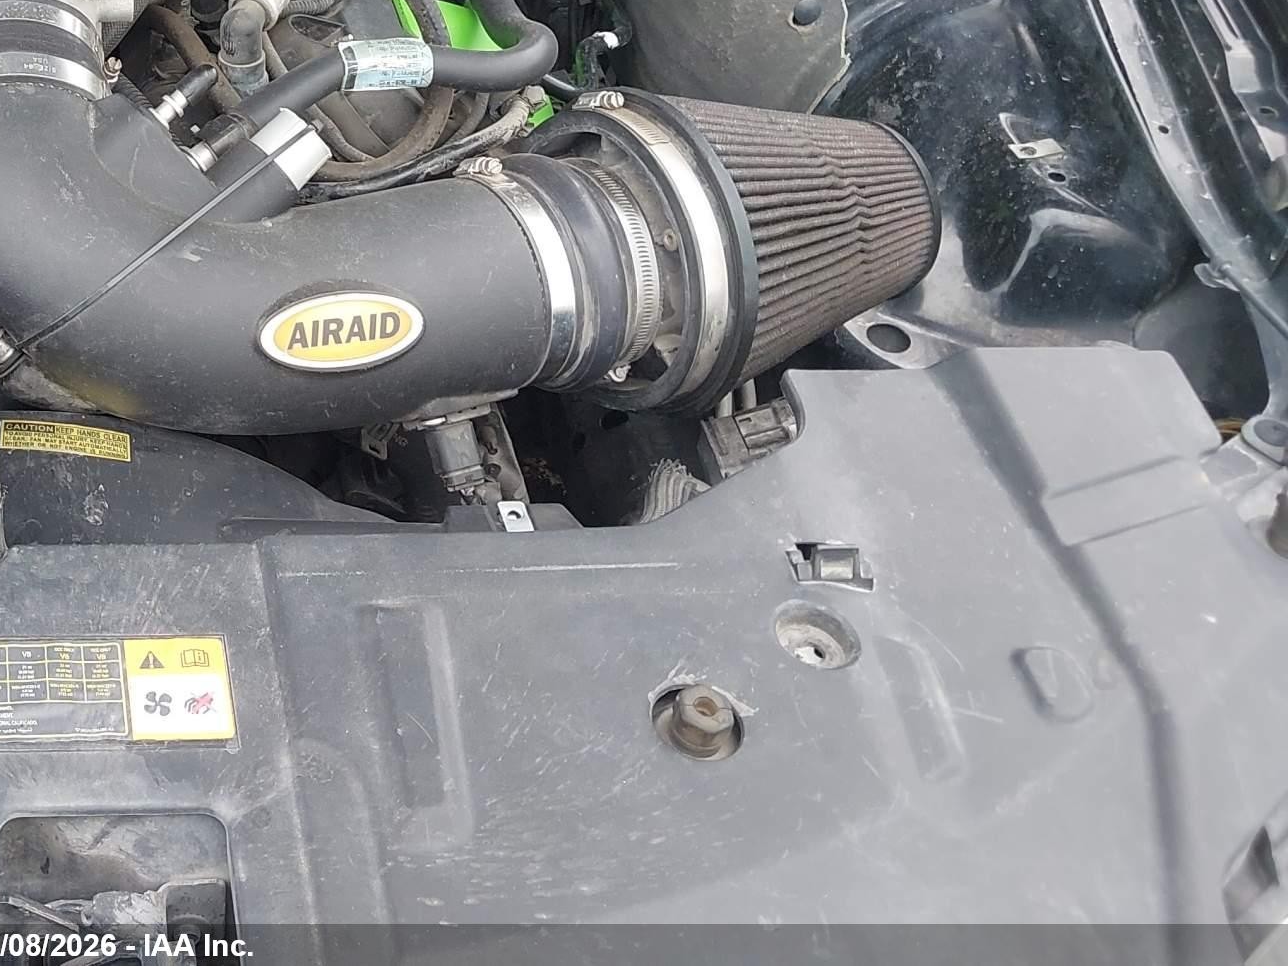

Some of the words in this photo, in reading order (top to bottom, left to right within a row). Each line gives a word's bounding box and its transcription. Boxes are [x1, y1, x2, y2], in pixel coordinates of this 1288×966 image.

[287, 311, 401, 350] AIRAID
[5, 422, 54, 434] CAUTION
[56, 425, 75, 434] KEEP
[76, 428, 101, 439] HANDS
[103, 433, 127, 444] CLEAR
